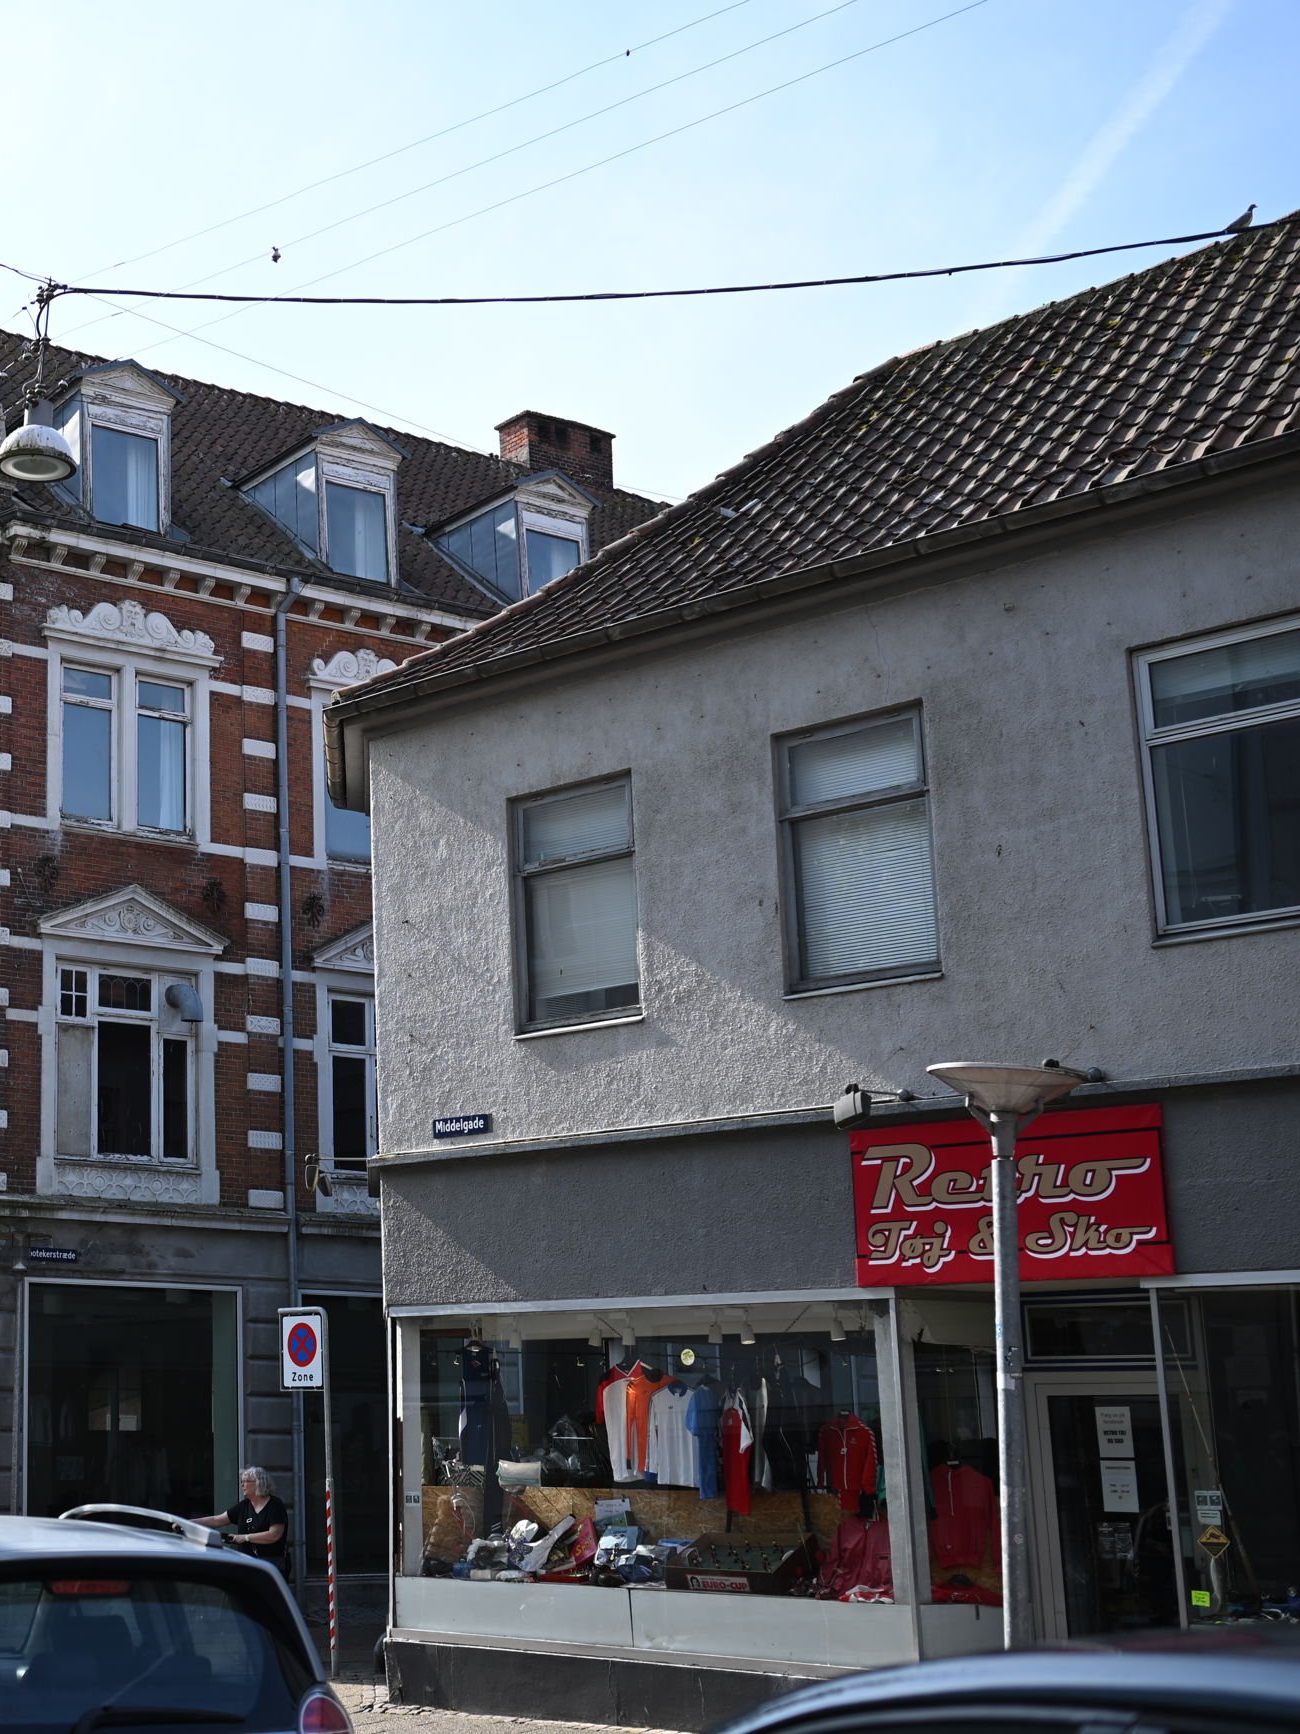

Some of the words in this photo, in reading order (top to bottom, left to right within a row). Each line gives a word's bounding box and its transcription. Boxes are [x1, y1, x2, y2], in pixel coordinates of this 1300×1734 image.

[435, 1116, 485, 1133] Middelgade
[867, 1220, 955, 1273] Tøj
[1024, 1211, 1157, 1259] Sko
[30, 1249, 76, 1260] otekerstræde
[291, 1372, 314, 1382] Zone
[701, 1580, 748, 1590] EURO-CUP
